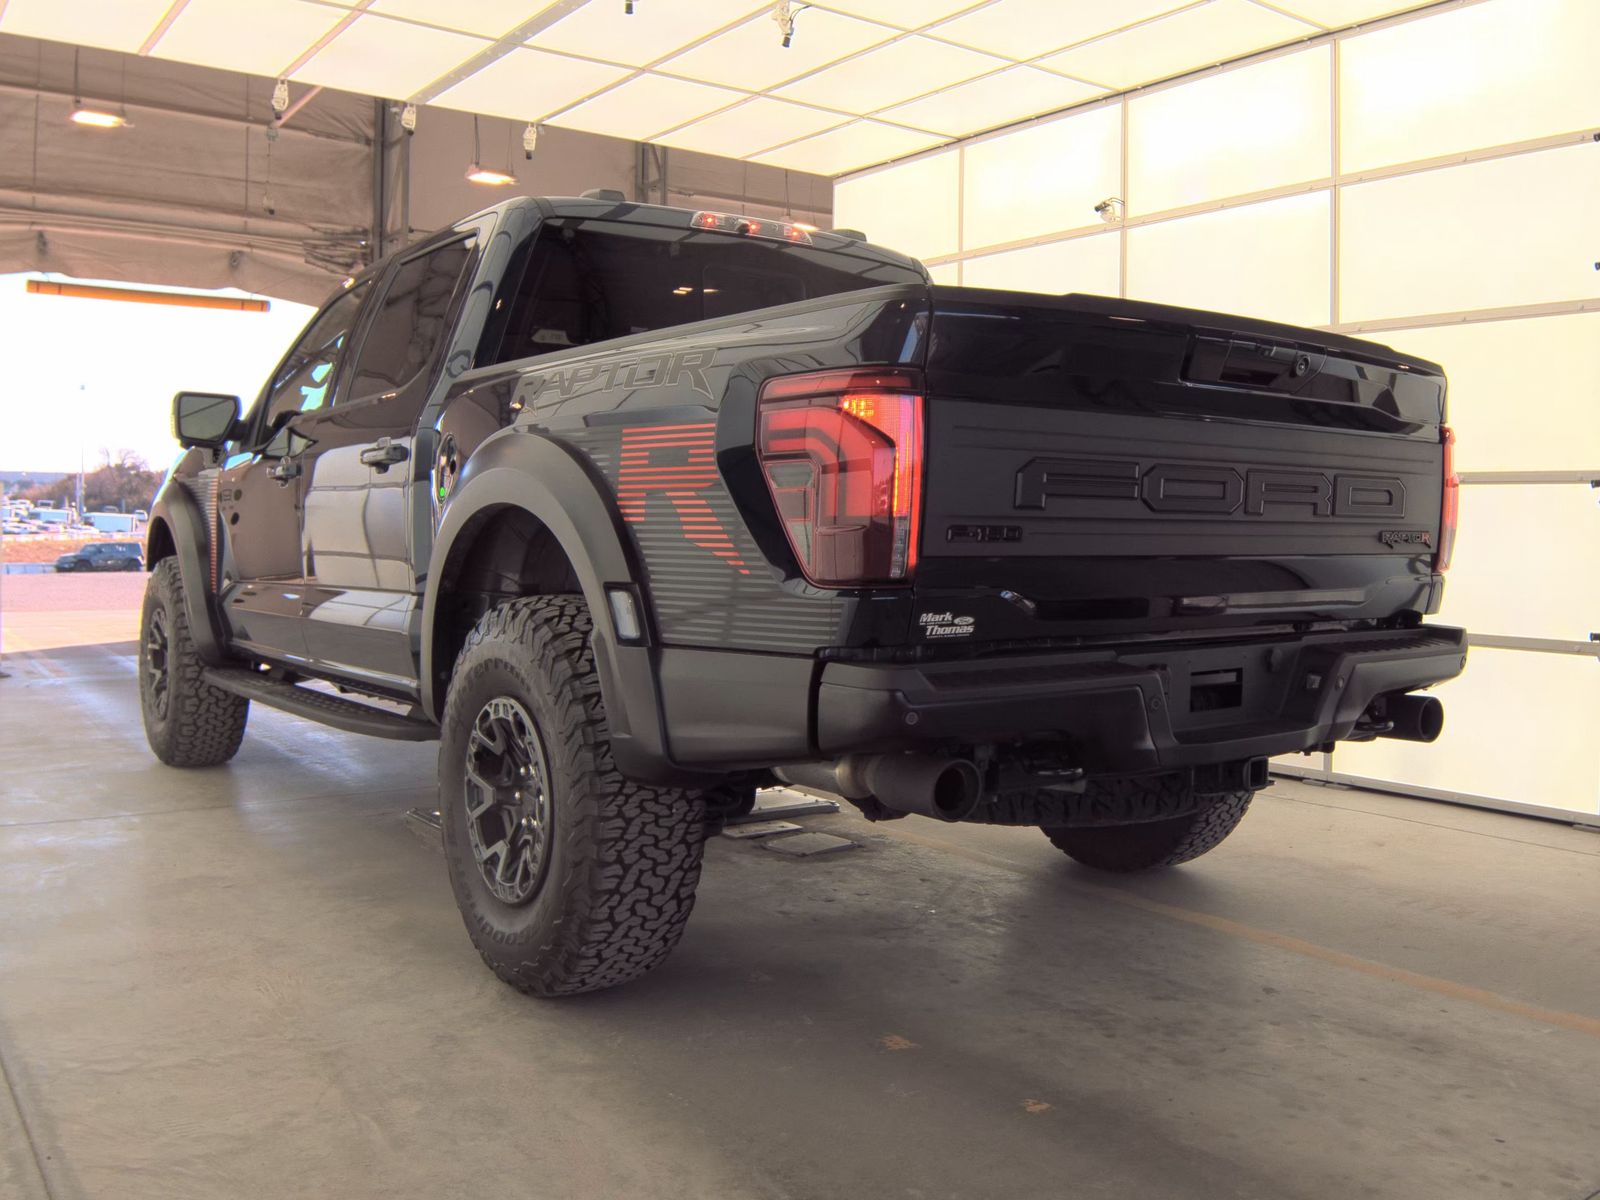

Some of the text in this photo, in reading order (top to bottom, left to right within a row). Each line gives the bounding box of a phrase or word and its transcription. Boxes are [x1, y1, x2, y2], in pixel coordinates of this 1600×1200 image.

[510, 348, 715, 417] RAPTOR
[1014, 456, 1407, 519] FORD
[1380, 530, 1431, 549] RAPTOR
[920, 612, 953, 623] Mark
[926, 625, 975, 636] Thomas
